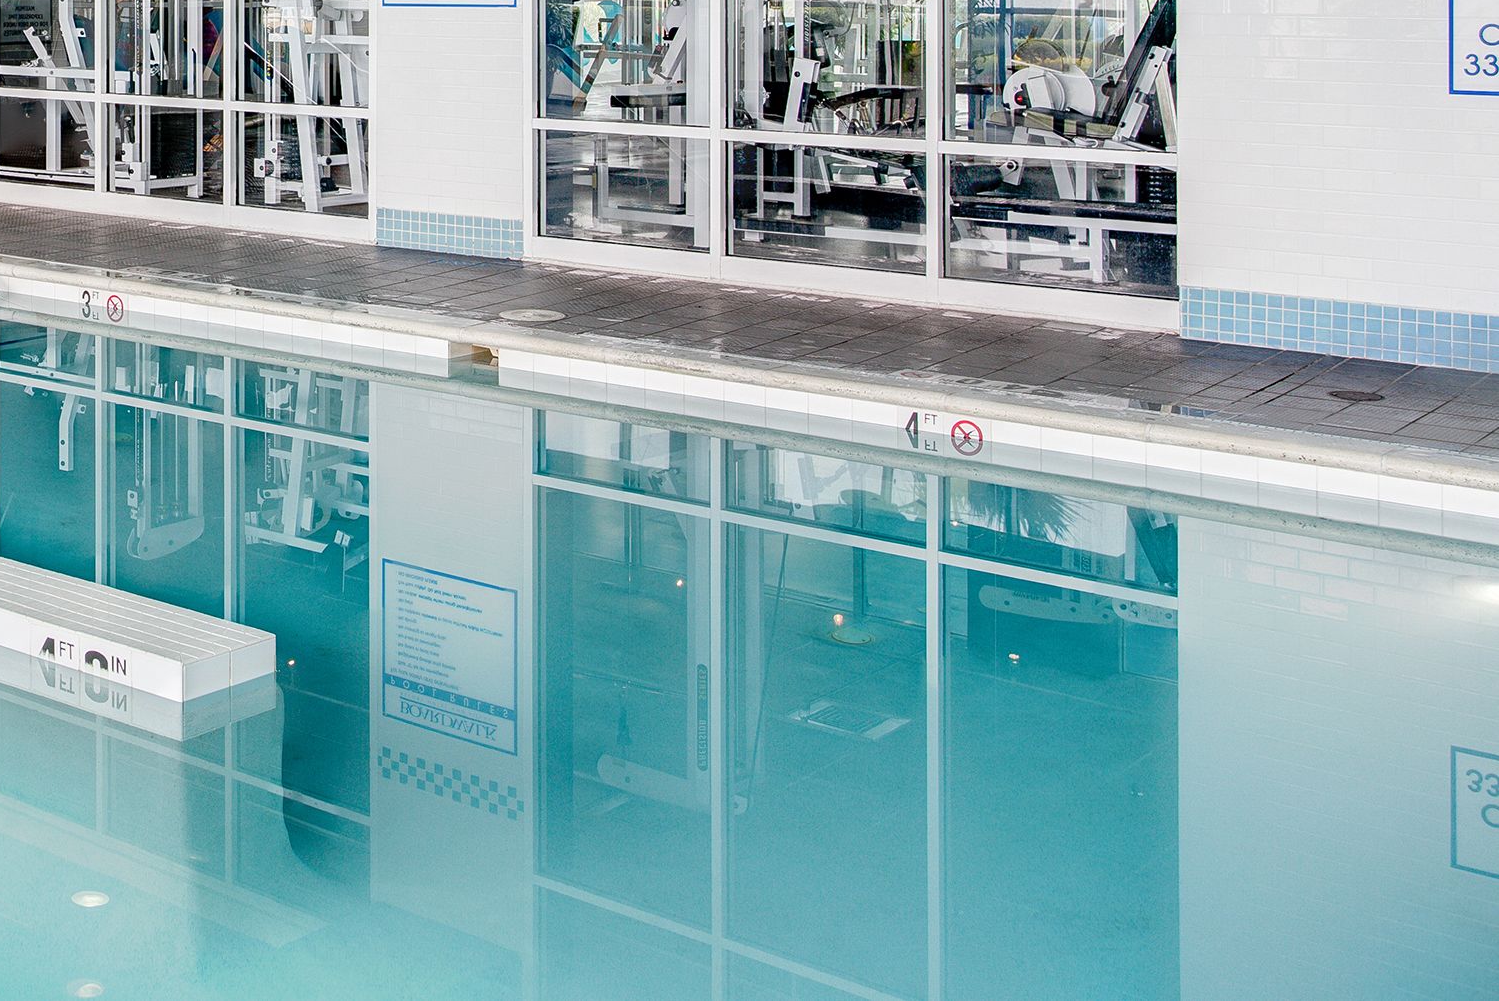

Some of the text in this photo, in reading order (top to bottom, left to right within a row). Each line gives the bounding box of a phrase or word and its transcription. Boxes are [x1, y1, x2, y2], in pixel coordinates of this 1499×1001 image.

[1464, 54, 1499, 76] 33
[924, 413, 937, 425] FT
[60, 641, 75, 660] FT
[111, 656, 126, 676] IN
